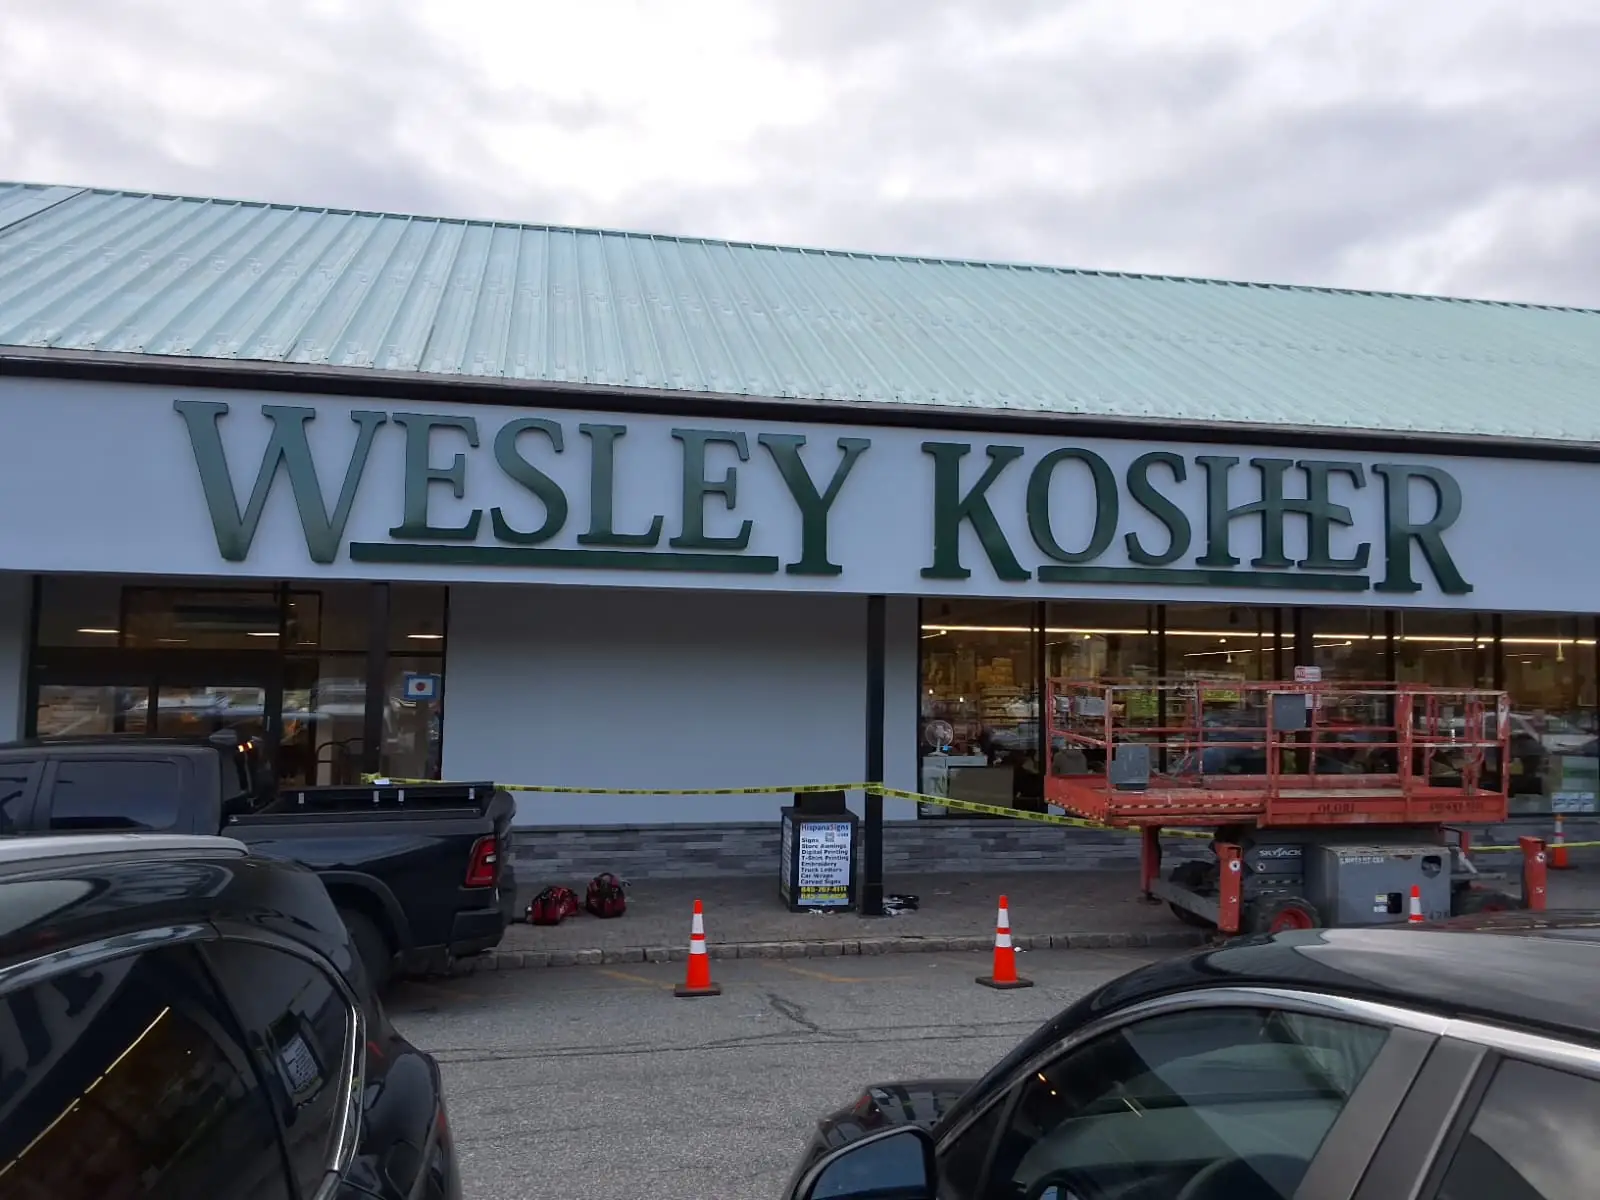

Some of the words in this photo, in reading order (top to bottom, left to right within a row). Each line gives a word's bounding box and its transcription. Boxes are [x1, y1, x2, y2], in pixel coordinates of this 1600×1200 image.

[173, 400, 871, 575] WESLEY
[919, 442, 1473, 594] KOSHER
[1258, 847, 1303, 857] SKYJACK
